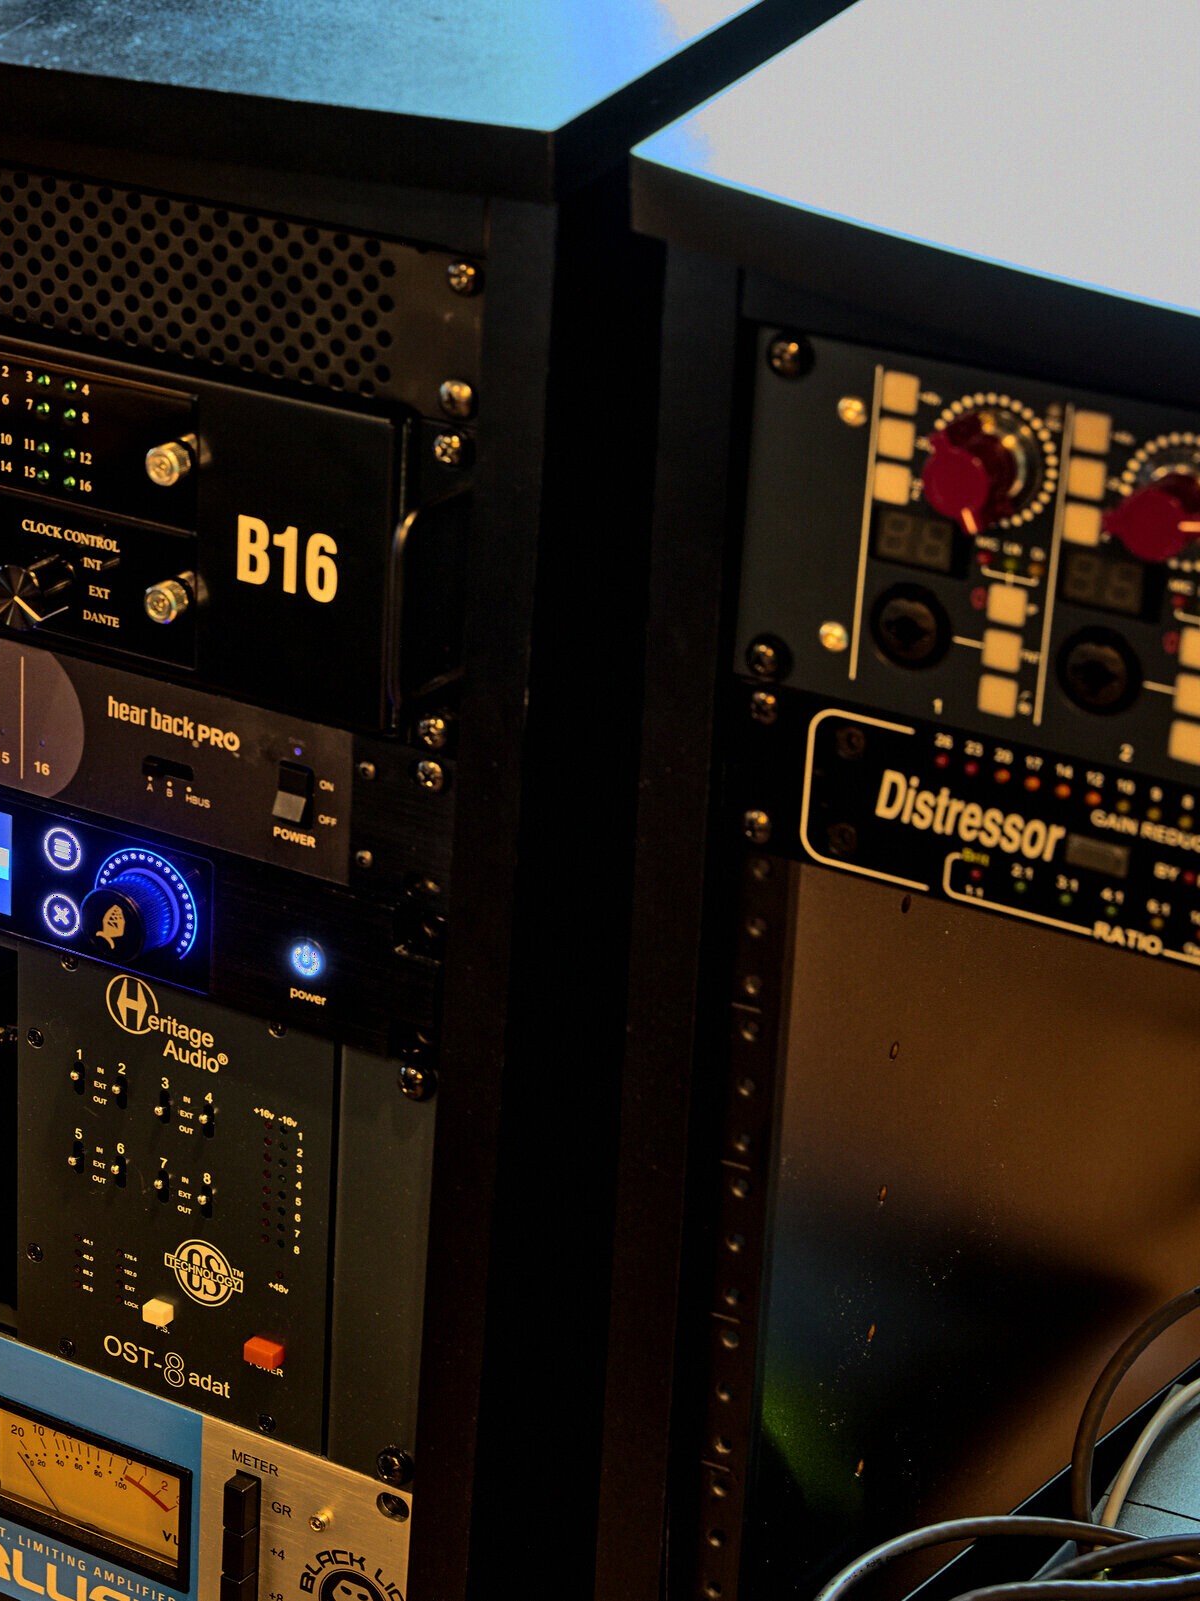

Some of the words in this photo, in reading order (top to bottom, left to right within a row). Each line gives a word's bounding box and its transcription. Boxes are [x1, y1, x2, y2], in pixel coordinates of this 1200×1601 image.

[1, 433, 13, 446] 10
[24, 438, 35, 451] 11
[80, 451, 92, 465] 12
[0, 460, 12, 473] 14
[24, 466, 36, 478] 15
[79, 479, 92, 492] 16
[22, 519, 62, 539] CLOCK
[64, 529, 120, 553] CONTROL
[83, 557, 102, 571] INT
[237, 514, 338, 603] B16
[88, 585, 111, 600] EXT
[83, 610, 120, 628] DANTE
[108, 696, 148, 727] hear
[151, 707, 194, 740] back
[197, 724, 240, 752] PRO
[1119, 743, 1134, 763] 2
[33, 761, 50, 776] 16
[146, 783, 154, 792] A
[166, 788, 173, 798] B
[319, 779, 334, 792] ON
[318, 814, 337, 827] OFF
[875, 769, 1066, 862] Distressor
[1090, 809, 1139, 836] GAIN
[273, 826, 316, 848] POWER
[1093, 920, 1163, 955] RATIO
[290, 987, 326, 1006] power
[76, 1049, 82, 1060] 1
[118, 1063, 126, 1075] 2
[93, 1096, 108, 1106] OUT
[161, 1077, 170, 1089] 3
[204, 1092, 213, 1104] 4
[75, 1128, 83, 1139] 5
[116, 1143, 125, 1154] 6
[179, 1125, 194, 1135] OUT
[92, 1175, 106, 1184] OUT
[159, 1157, 168, 1169] 7
[203, 1173, 211, 1185] 8
[177, 1205, 192, 1215] OUT
[167, 1254, 241, 1291] TECHNOLOGY
[104, 1335, 185, 1388] OST-8
[188, 1370, 231, 1399] adat
[10, 1424, 25, 1438] 20
[32, 1423, 45, 1436] 10
[55, 1459, 65, 1468] 40
[74, 1463, 83, 1472] 60
[93, 1470, 103, 1478] 80
[114, 1480, 128, 1491] 100
[232, 1449, 279, 1477] METER
[271, 1501, 292, 1518] GR
[18, 1534, 86, 1571] LIMITING
[270, 1547, 285, 1561] +4
[300, 1550, 366, 1594] BLACK
